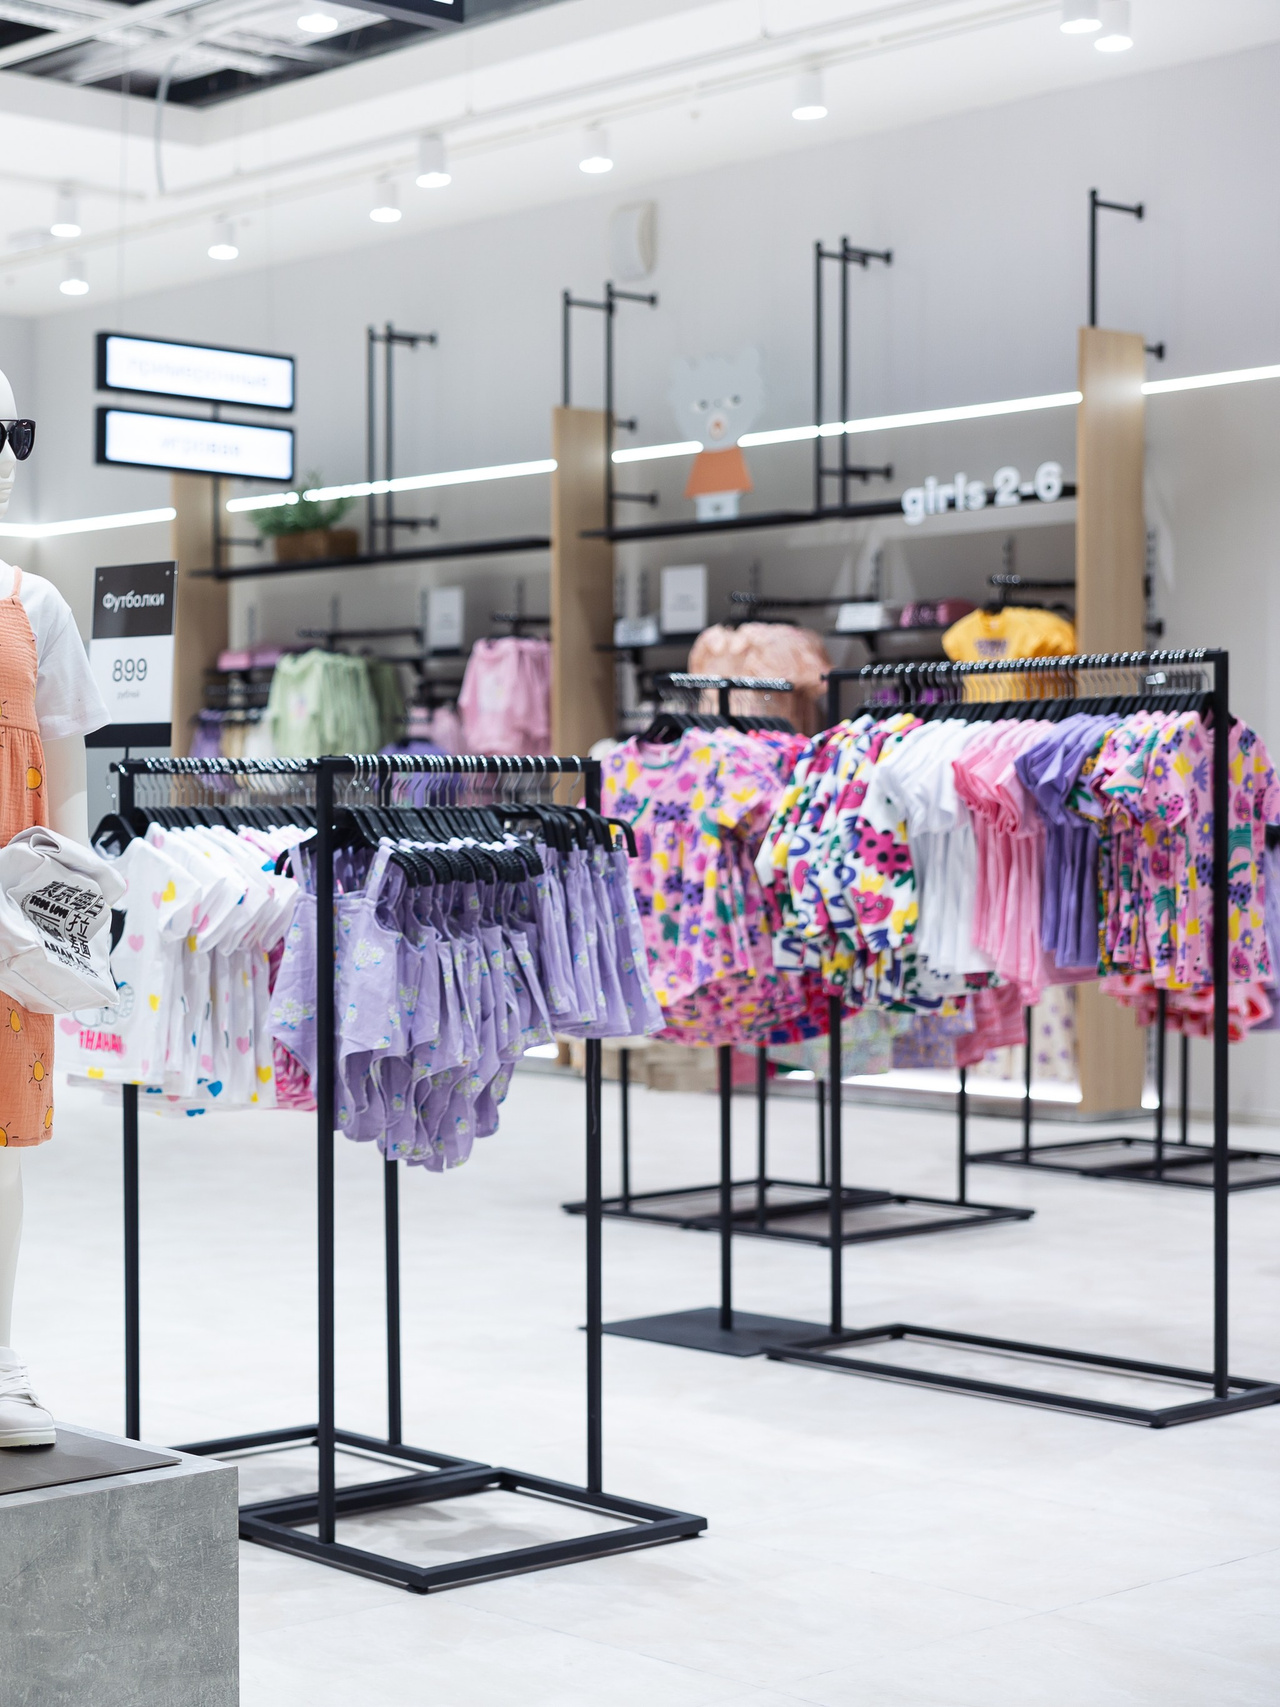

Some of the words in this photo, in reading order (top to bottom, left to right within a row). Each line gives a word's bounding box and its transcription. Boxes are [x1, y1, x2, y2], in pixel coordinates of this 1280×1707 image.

[901, 472, 986, 526] girls
[993, 460, 1063, 508] 2-6
[102, 590, 165, 613] Футболки
[112, 657, 148, 682] 899
